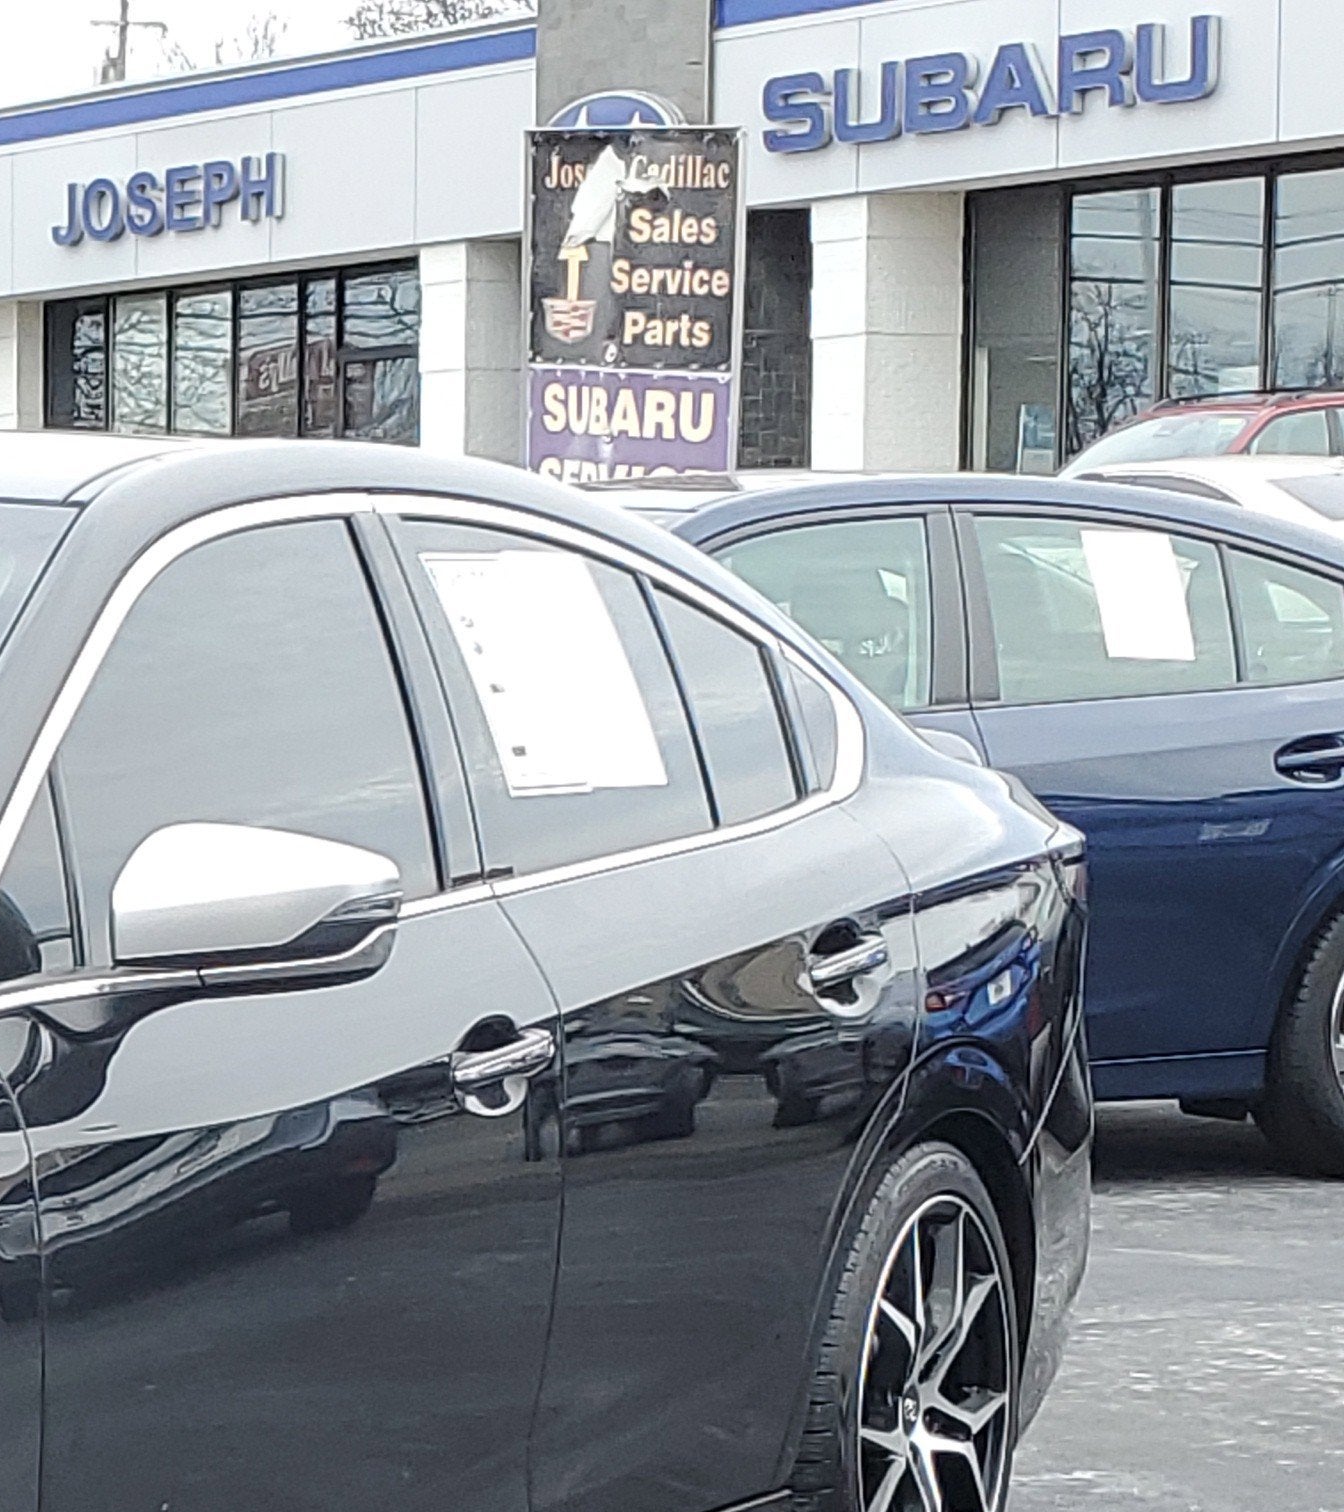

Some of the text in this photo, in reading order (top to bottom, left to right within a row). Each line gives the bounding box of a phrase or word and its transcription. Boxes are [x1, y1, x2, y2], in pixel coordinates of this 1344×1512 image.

[762, 14, 1221, 154] SUBARU
[52, 151, 286, 247] JOSEPH
[629, 208, 717, 245] Sales
[610, 258, 730, 297] Service
[622, 310, 713, 348] Parts
[542, 382, 716, 443] SUBARU
